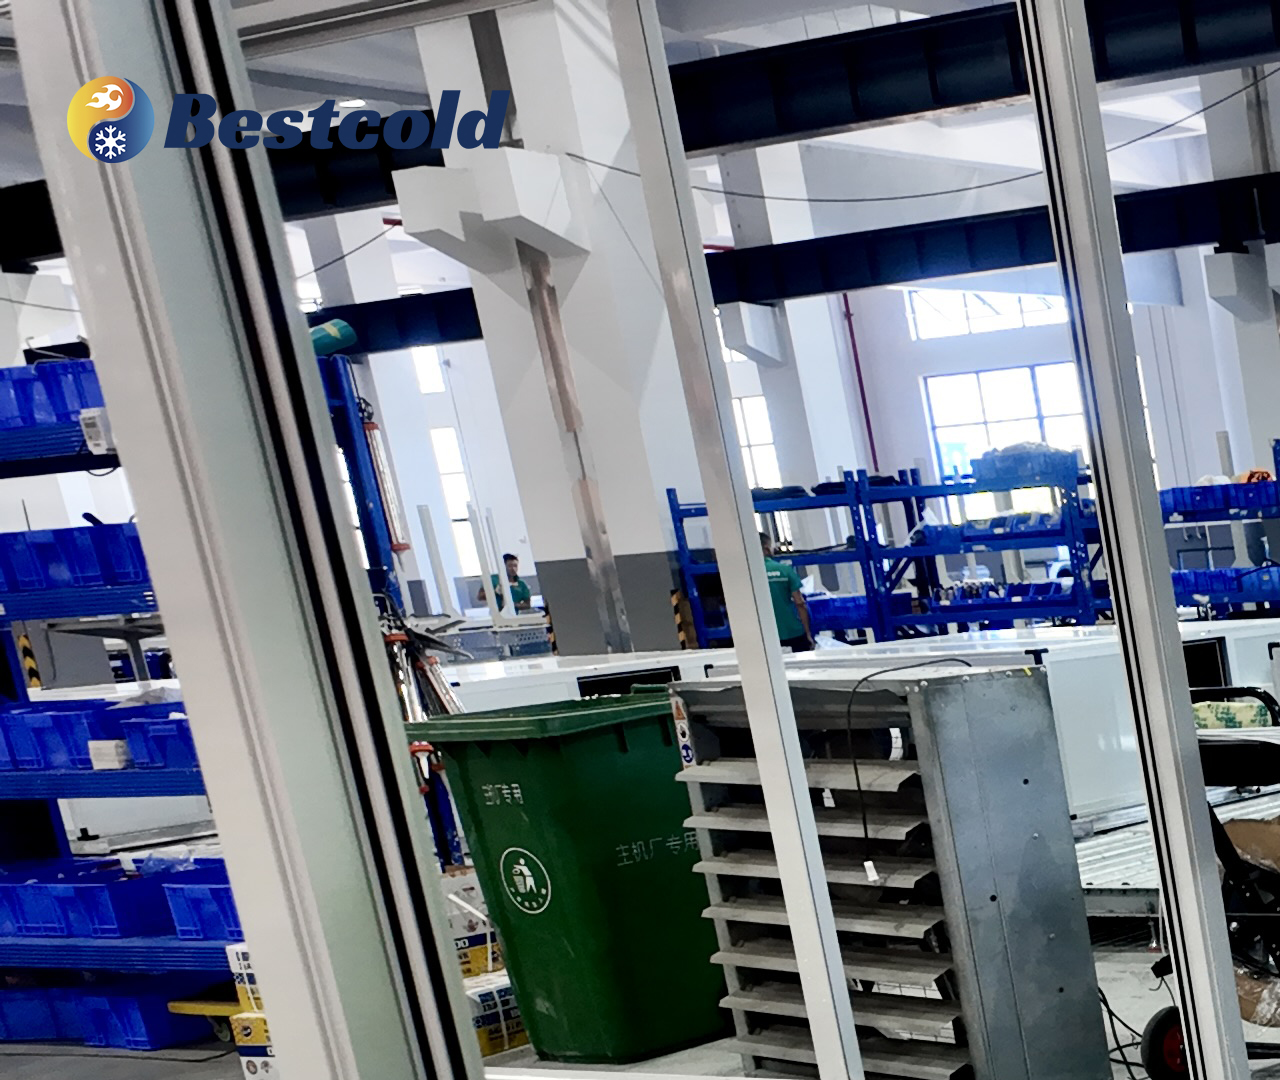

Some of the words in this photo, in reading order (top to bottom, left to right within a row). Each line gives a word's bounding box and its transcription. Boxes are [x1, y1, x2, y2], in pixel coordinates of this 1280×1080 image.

[614, 830, 699, 867] 主机厂专用
